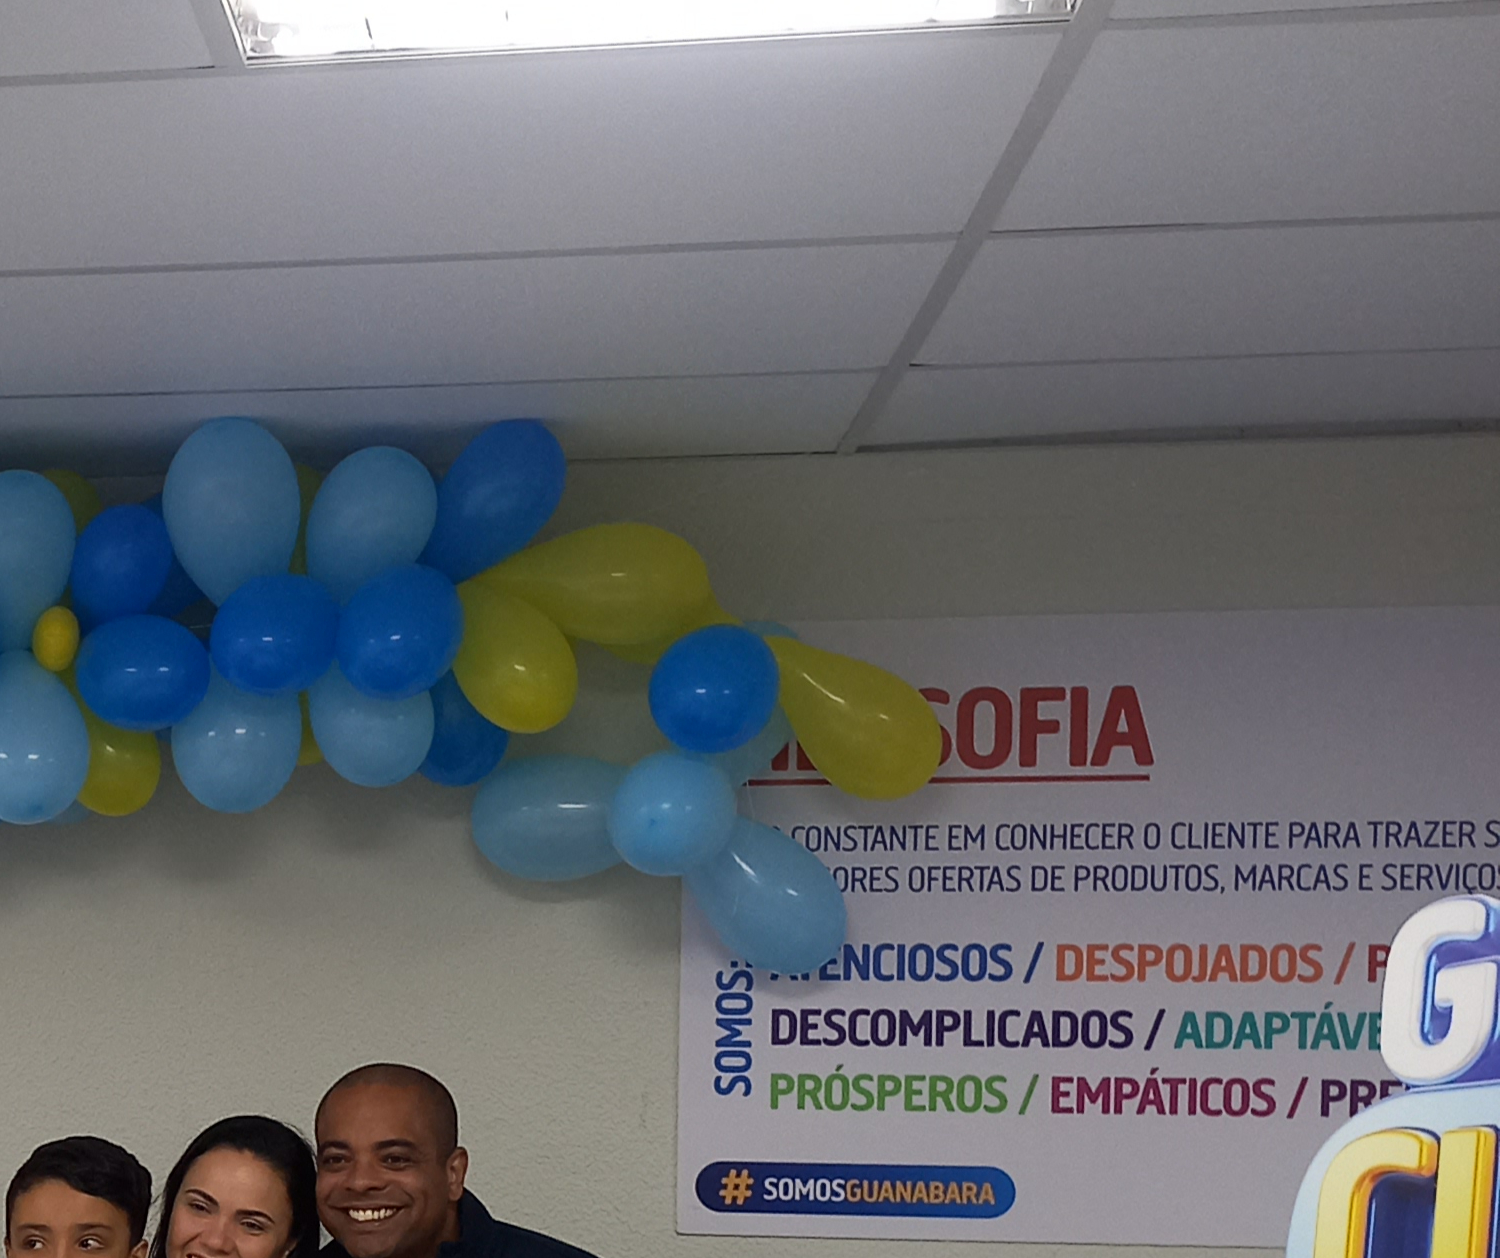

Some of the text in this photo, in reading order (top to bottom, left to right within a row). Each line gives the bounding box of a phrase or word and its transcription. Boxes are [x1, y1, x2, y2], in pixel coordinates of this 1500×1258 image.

[947, 823, 986, 851] EM
[994, 822, 1134, 851] CONHECER
[1143, 822, 1161, 850] O
[1170, 821, 1279, 850] CLIENTE
[1288, 821, 1361, 849] PARA
[1366, 820, 1476, 849] TRAZER
[908, 865, 1022, 893] OFERTAS
[1030, 865, 1066, 892] DE
[1073, 864, 1226, 894] PRODUTOS,
[1233, 863, 1350, 892] MARCAS
[1358, 863, 1374, 891] E
[770, 943, 1013, 983] ENCIOSOS
[1055, 943, 1324, 983] DESPOJADOS
[769, 1008, 1134, 1049] DESCOMPLICADOS
[769, 1064, 1008, 1115] PRÓSPEROS
[1050, 1067, 1276, 1118] EMPÁTICOS
